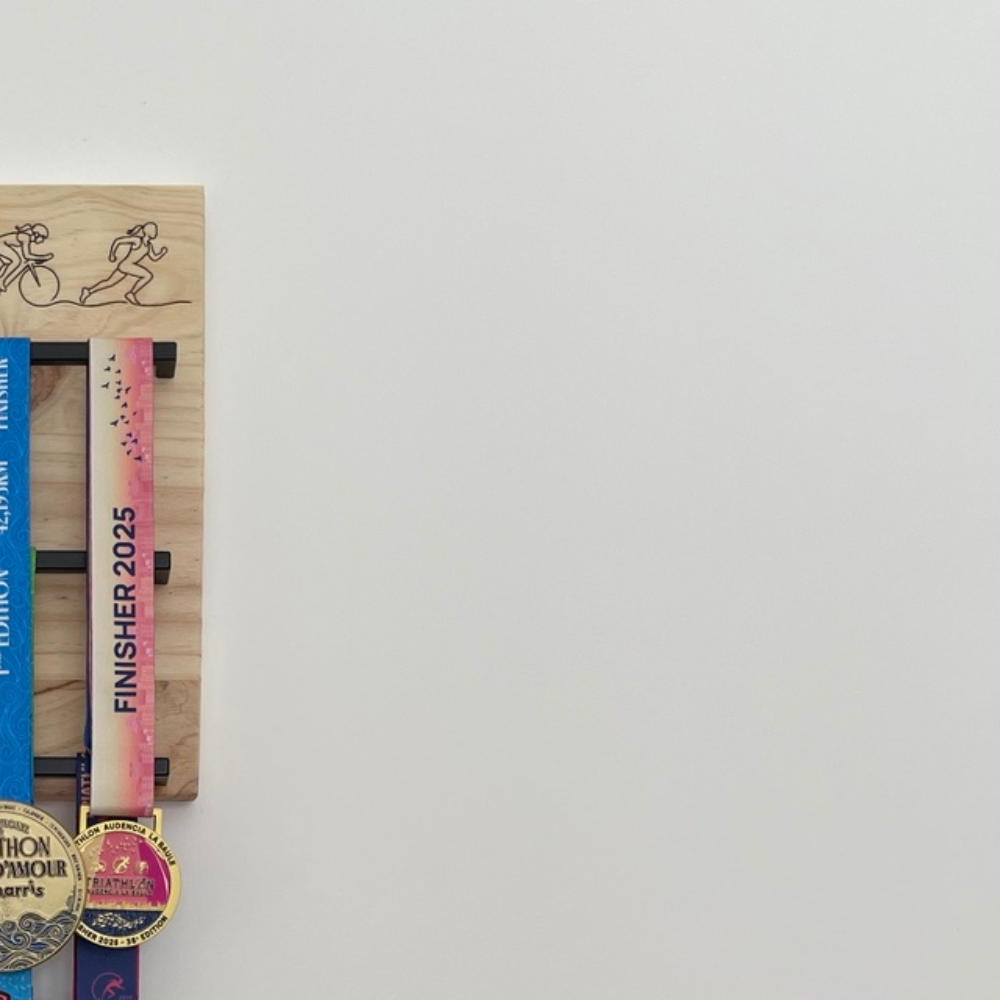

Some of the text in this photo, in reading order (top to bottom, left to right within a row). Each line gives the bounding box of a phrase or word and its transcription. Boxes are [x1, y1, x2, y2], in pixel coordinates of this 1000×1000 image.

[112, 506, 137, 714] FINISHER 2025
[75, 827, 100, 846] THLON
[104, 822, 147, 835] AUDENCIA
[157, 840, 177, 866] BAULE
[140, 915, 168, 940] EDITION
